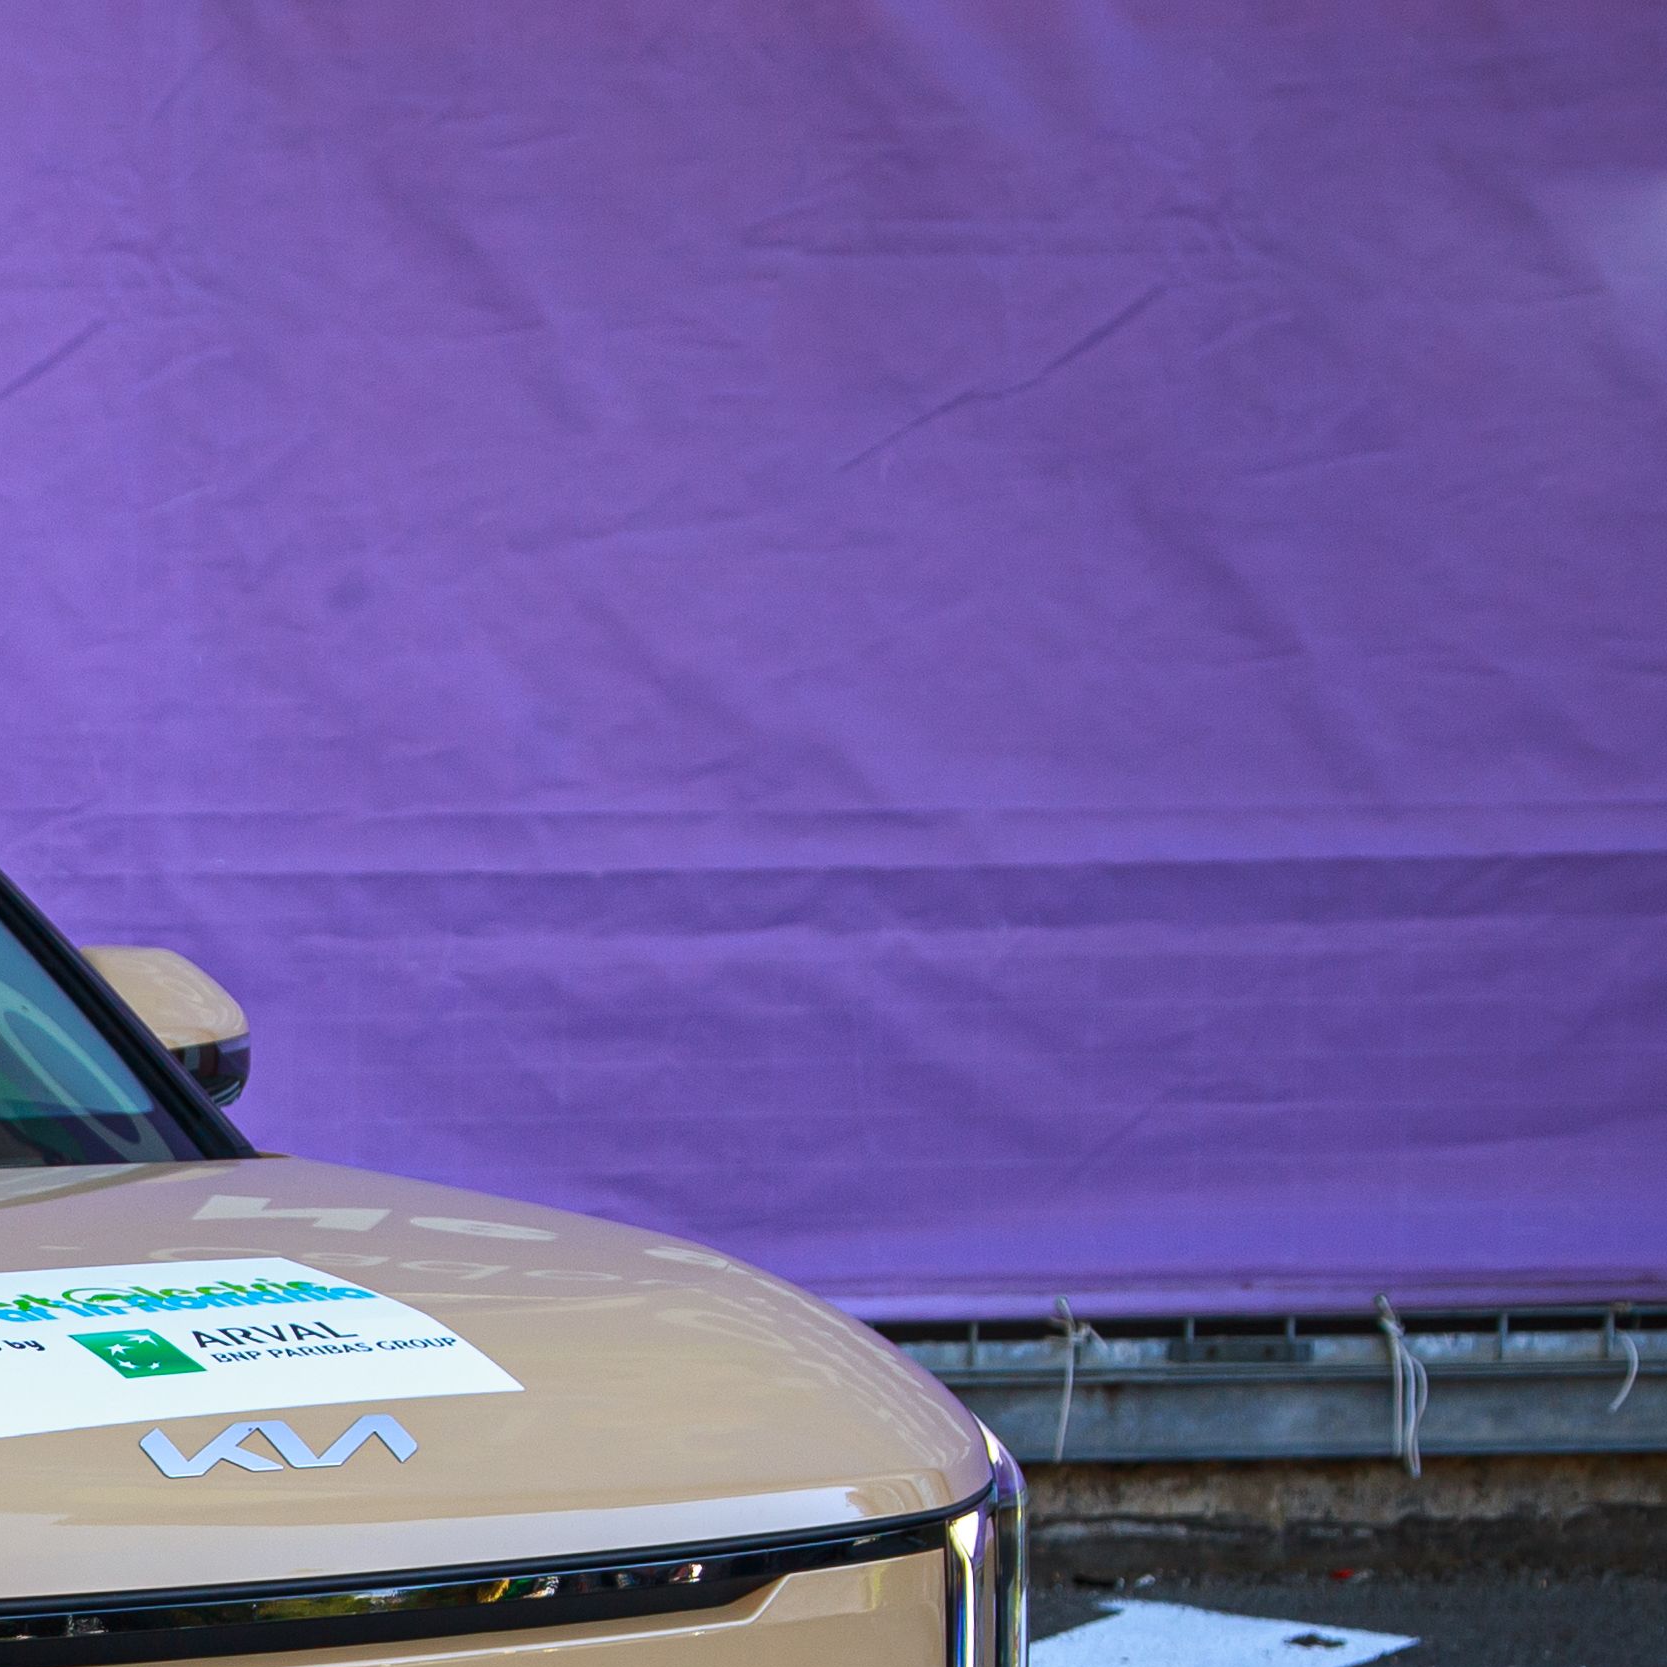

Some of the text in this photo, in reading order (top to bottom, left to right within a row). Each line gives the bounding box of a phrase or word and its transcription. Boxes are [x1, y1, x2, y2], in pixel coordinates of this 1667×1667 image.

[3, 1339, 46, 1352] by
[191, 1321, 358, 1348] ARVAL
[210, 1336, 458, 1363] BNP PARIBAS GROUP
[139, 1414, 418, 1479] KIA
